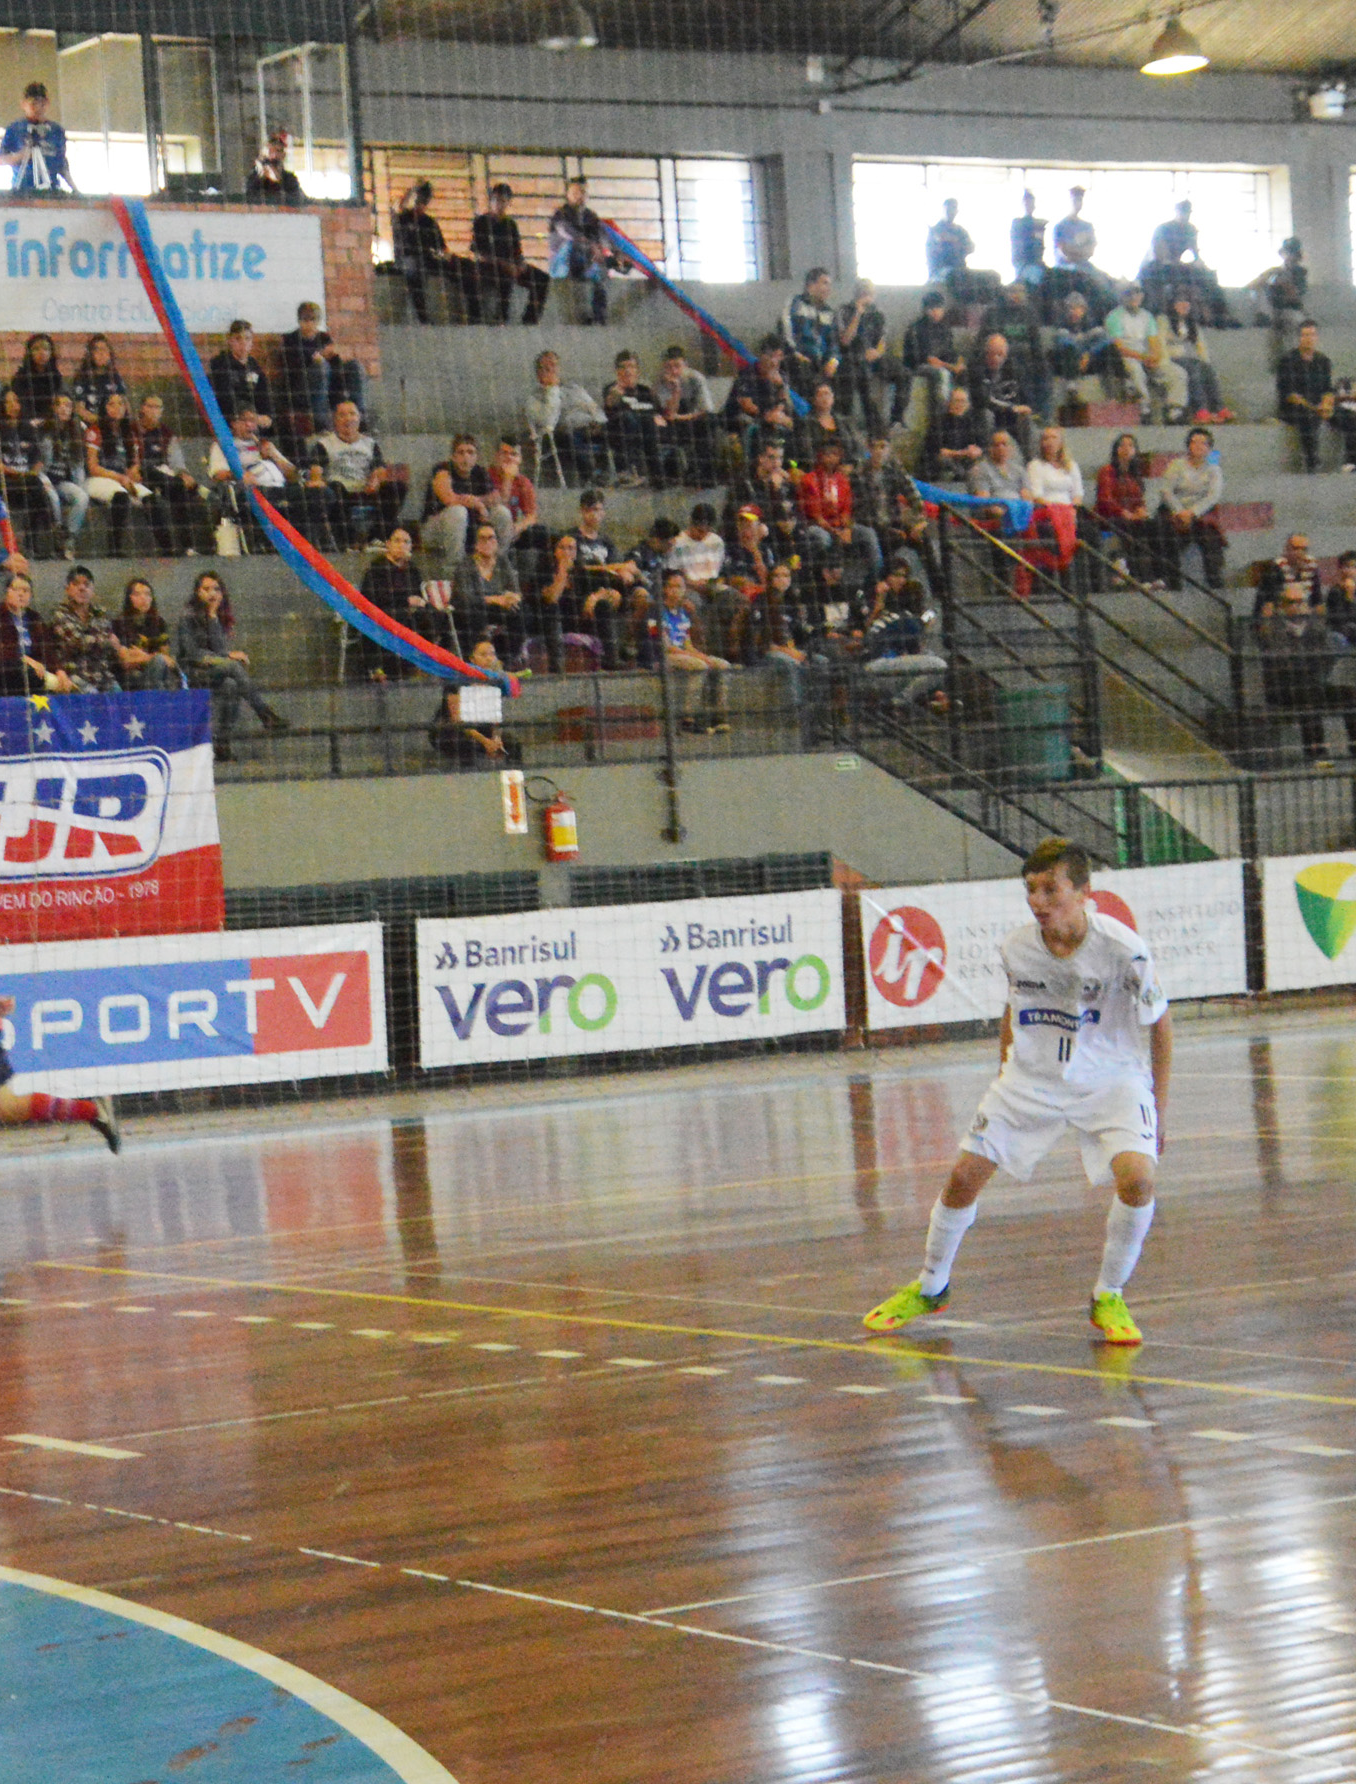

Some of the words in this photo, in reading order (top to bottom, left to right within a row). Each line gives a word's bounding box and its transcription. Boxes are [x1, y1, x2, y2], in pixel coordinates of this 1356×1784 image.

[30, 891, 53, 909] DO
[465, 931, 578, 969] Banrisul
[687, 914, 794, 950] Banrisul
[435, 971, 619, 1041] vero
[660, 953, 831, 1021] vero
